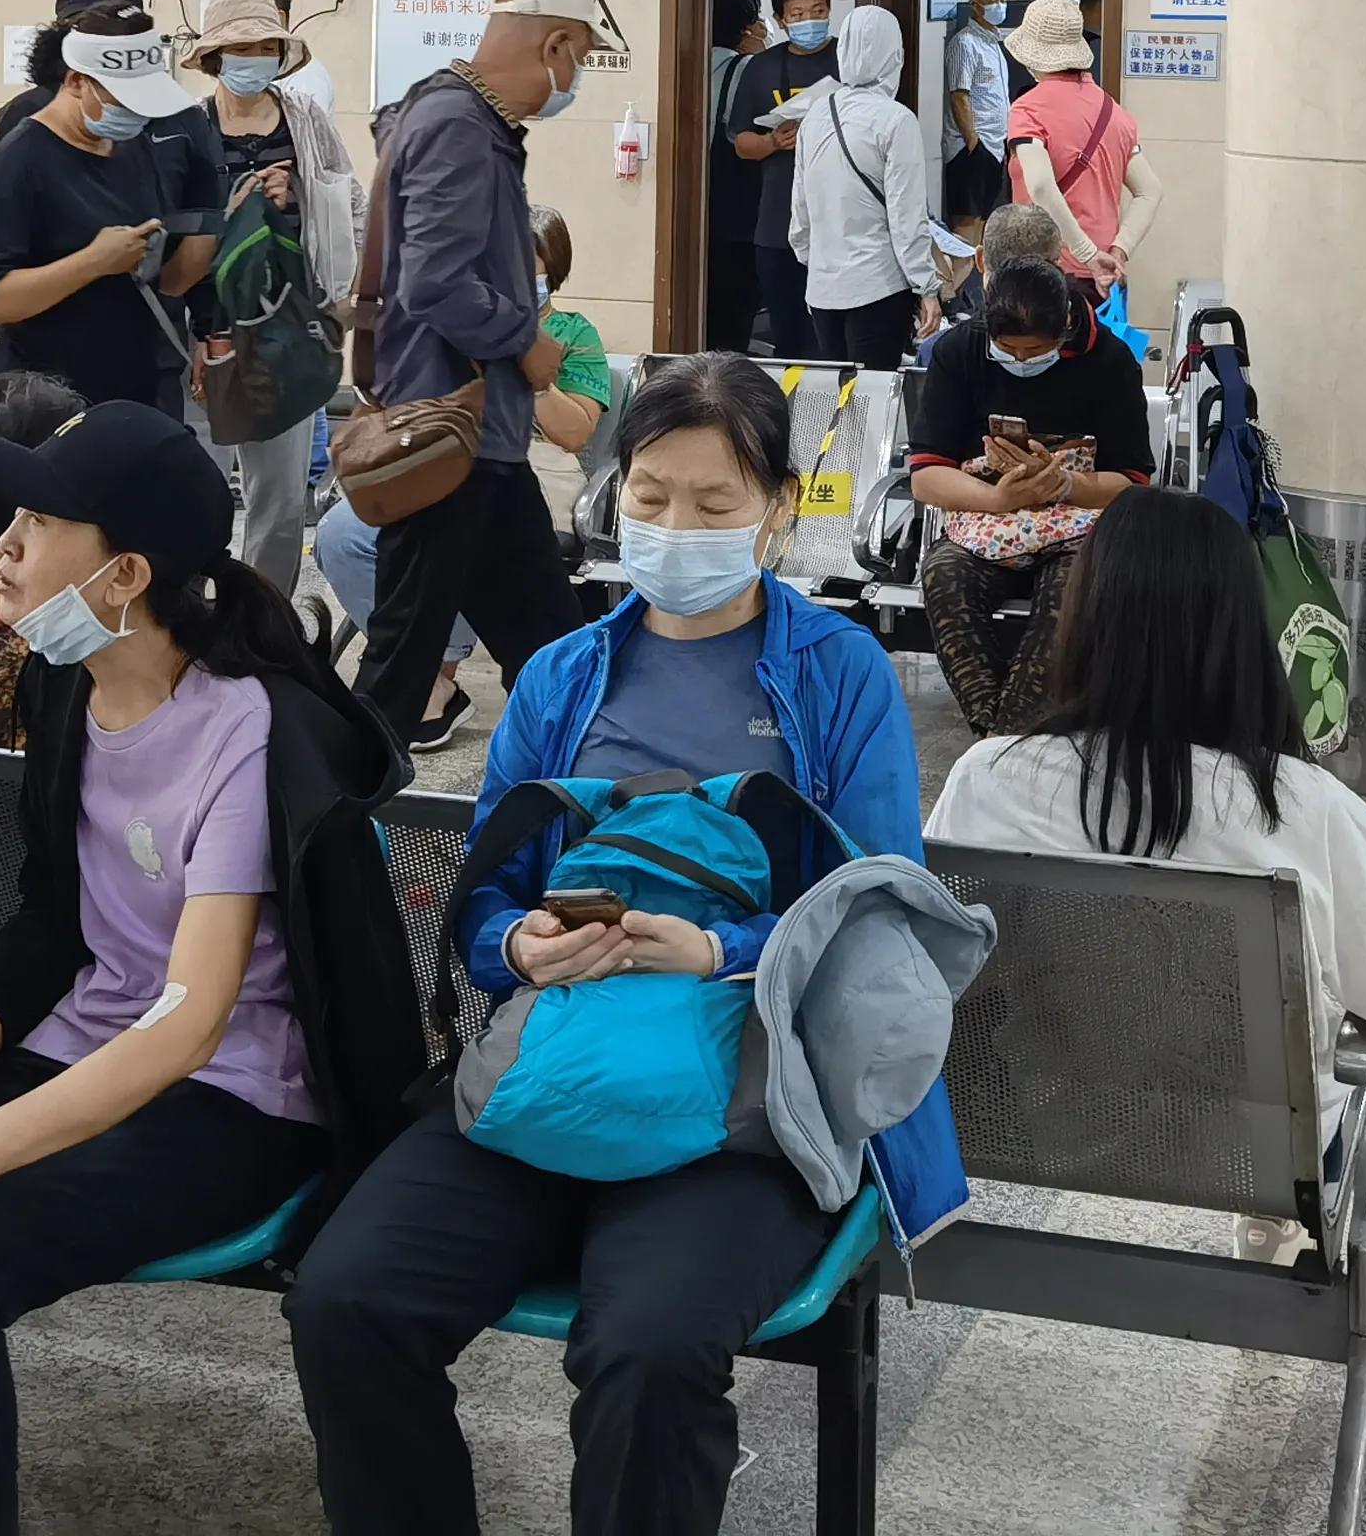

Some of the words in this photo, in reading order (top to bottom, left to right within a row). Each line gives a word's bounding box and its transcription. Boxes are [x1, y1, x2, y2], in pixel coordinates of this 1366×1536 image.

[1130, 48, 1214, 61] 保管好个人物品
